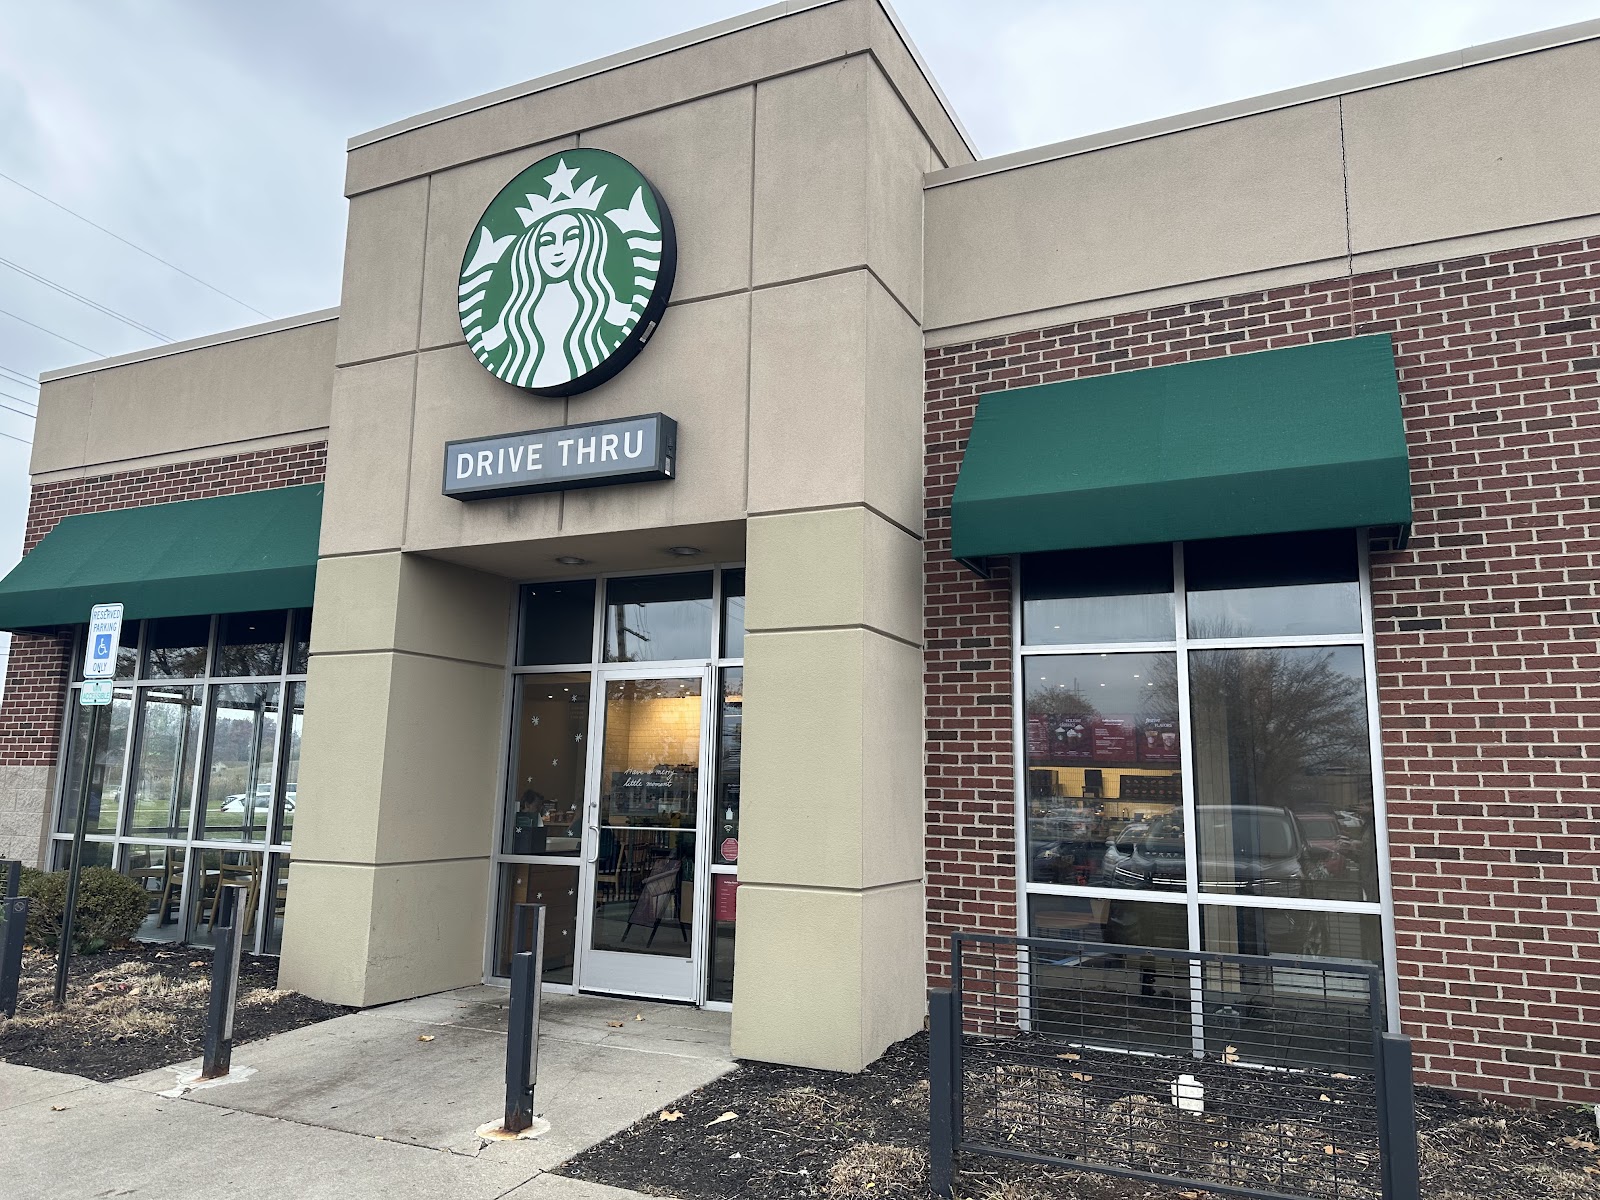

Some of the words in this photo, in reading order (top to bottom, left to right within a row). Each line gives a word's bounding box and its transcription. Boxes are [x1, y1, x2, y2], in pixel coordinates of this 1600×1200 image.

[456, 443, 543, 480] DRIVE
[558, 430, 644, 467] THRU
[93, 609, 120, 620] RESERVED
[93, 622, 117, 632] PARKING
[93, 662, 108, 672] ONLY
[624, 766, 644, 775] Have
[655, 769, 677, 782] merry
[623, 776, 643, 787] little
